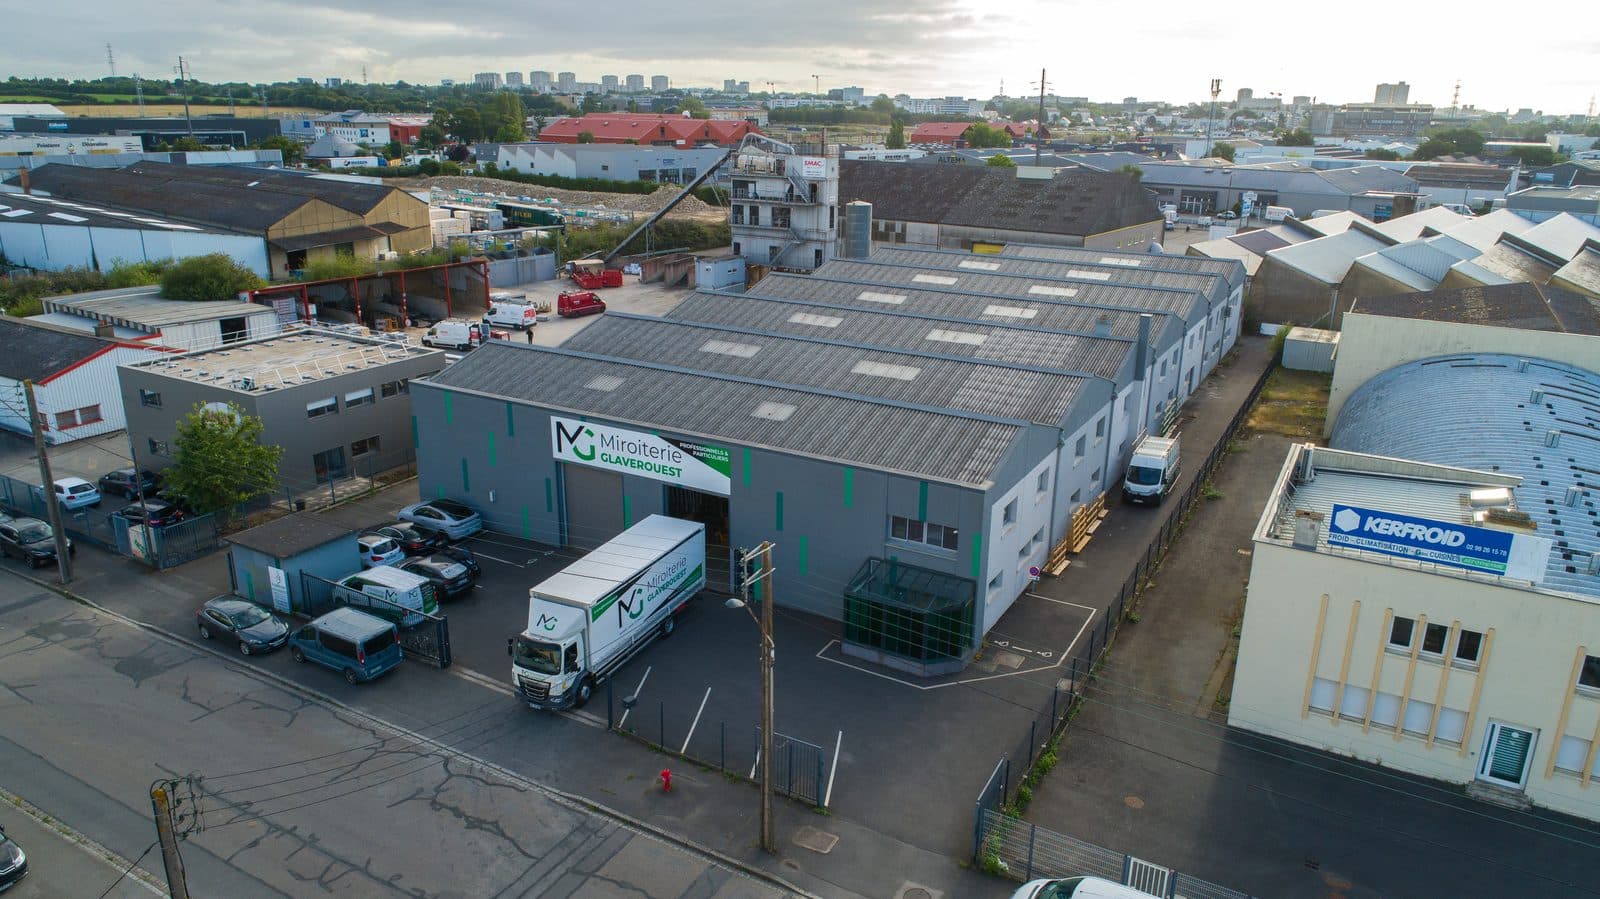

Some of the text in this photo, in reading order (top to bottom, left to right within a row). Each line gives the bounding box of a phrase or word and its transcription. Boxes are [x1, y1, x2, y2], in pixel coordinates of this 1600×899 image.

[600, 433, 682, 463] Miroiterie
[680, 442, 724, 456] PROFESSIONNELS
[693, 450, 729, 462] PARTICULIERS
[601, 453, 682, 478] GLAVEROUEST
[1363, 516, 1466, 547] KERFROID
[1329, 533, 1350, 543] FROID
[1356, 538, 1409, 553] CLIMATISATION
[1429, 551, 1461, 563] CUISINES
[646, 557, 687, 592] Miroiterie
[647, 567, 687, 602] GLAVEROUEST
